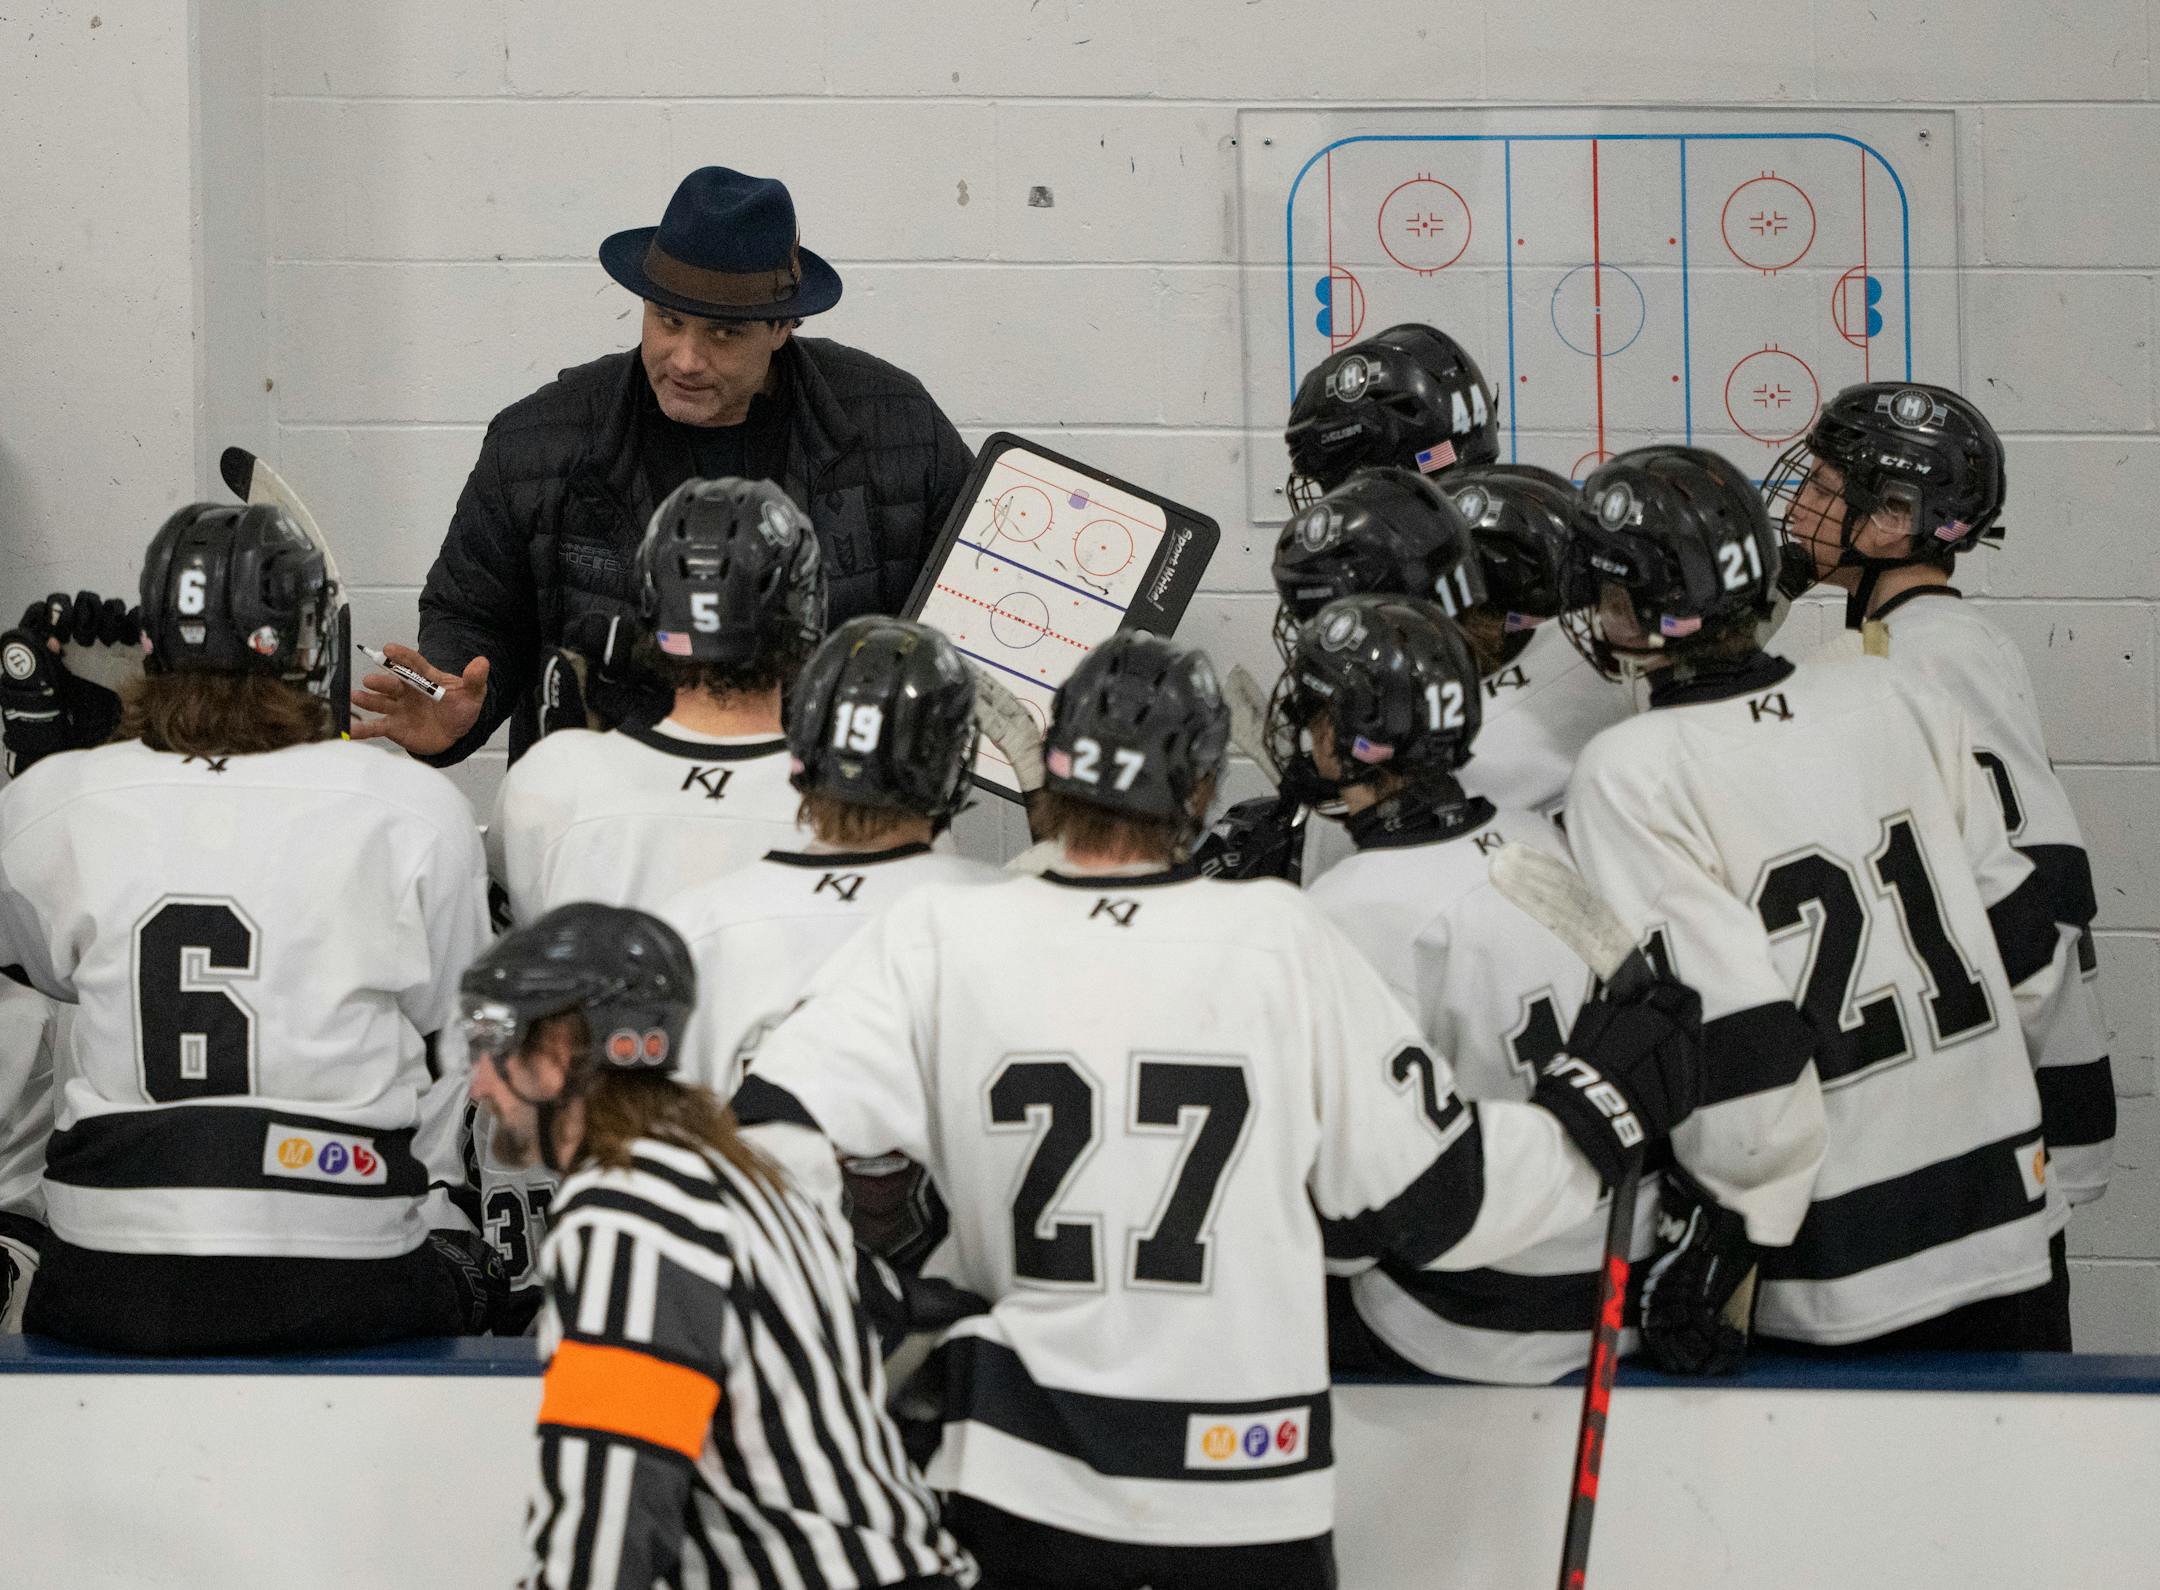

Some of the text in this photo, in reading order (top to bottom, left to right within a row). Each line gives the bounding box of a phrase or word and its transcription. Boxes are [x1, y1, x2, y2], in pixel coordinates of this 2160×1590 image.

[1880, 454, 1932, 475] CCM
[1718, 534, 1762, 592] 21
[178, 568, 207, 616] 6
[690, 593, 722, 633] 5
[1434, 564, 1473, 617] 11
[833, 700, 884, 754] 19
[1424, 680, 1466, 732] 12
[1070, 737, 1146, 792] 27
[1748, 808, 1999, 1096] 21
[130, 892, 262, 1103] 6
[979, 1051, 1261, 1296] 27
